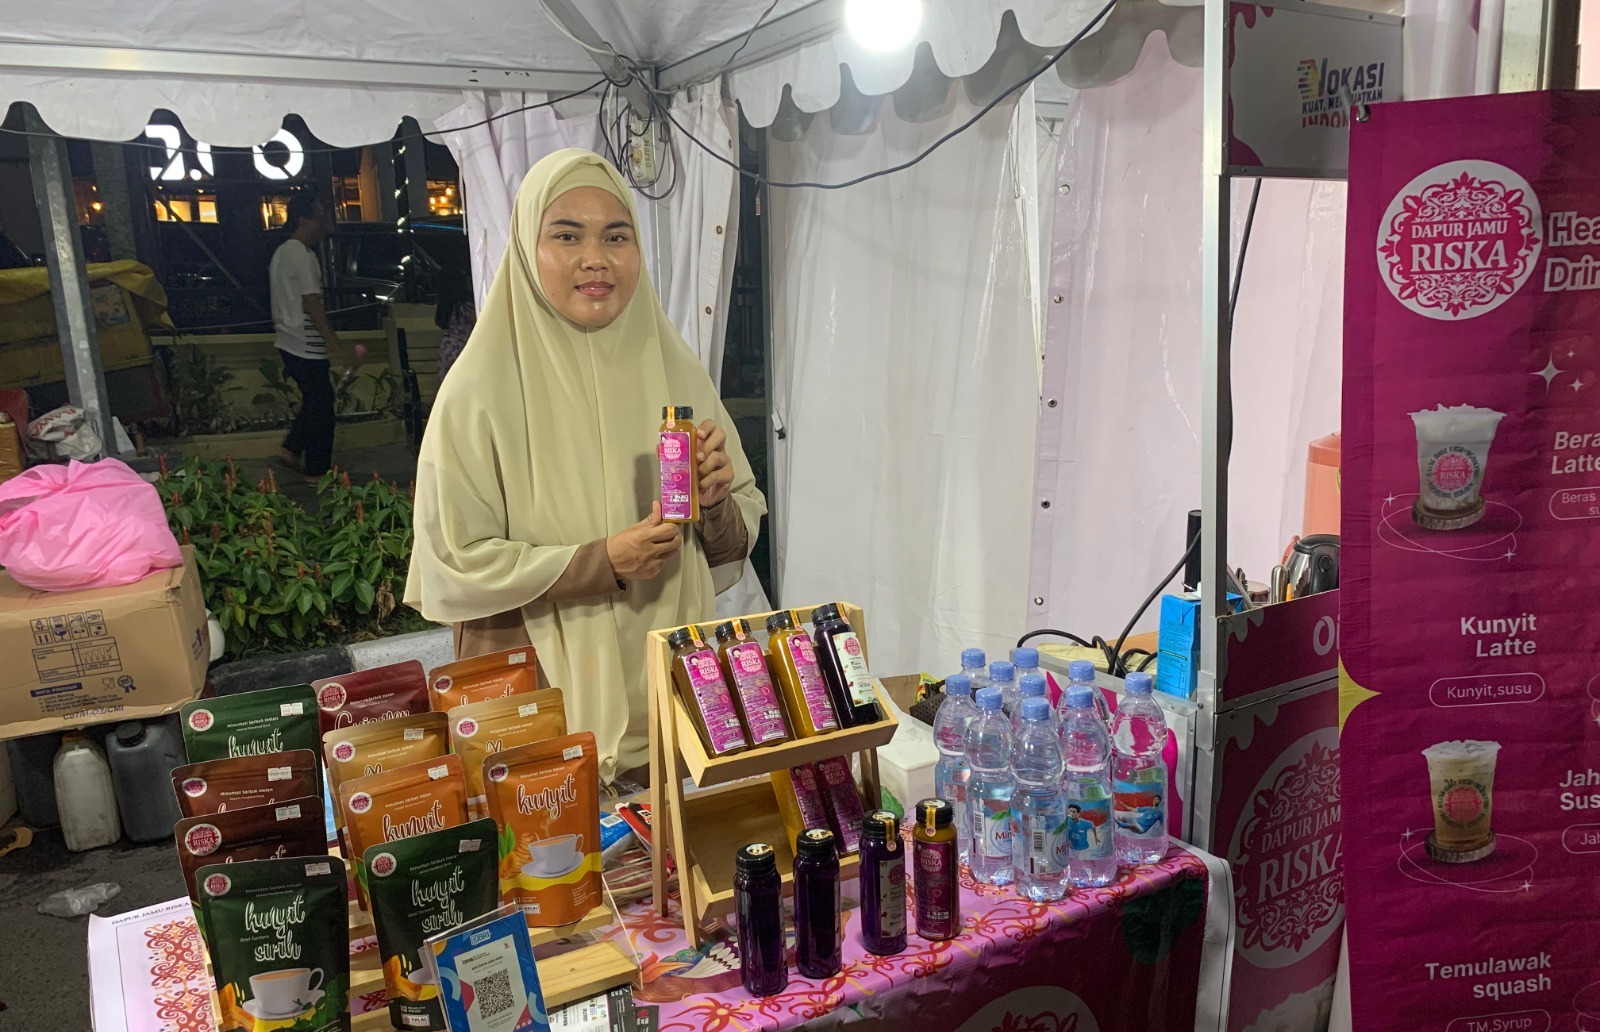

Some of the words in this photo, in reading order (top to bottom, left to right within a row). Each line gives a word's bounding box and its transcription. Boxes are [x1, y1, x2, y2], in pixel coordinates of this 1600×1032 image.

[1411, 222, 1463, 239] DAPUR
[1466, 220, 1508, 238] JAMU
[1410, 239, 1508, 272] RISKA
[1440, 471, 1466, 480] RISKA
[1561, 492, 1596, 504] Beras
[1461, 612, 1537, 637] Kunyit
[1475, 638, 1537, 657] Latte
[52, 684, 78, 693] PRODUK
[1447, 683, 1532, 700] Kunyit,susu
[517, 773, 577, 819] kunyit
[193, 836, 215, 846] RISKA
[1261, 815, 1312, 854] DAPUR
[412, 866, 465, 909] kunyit
[141, 908, 164, 917] JAMU
[165, 901, 190, 911] RISKA
[245, 894, 306, 939] kunyit
[254, 929, 302, 962] sirih
[1425, 952, 1552, 980] Temulawak
[1473, 973, 1552, 1001] squash
